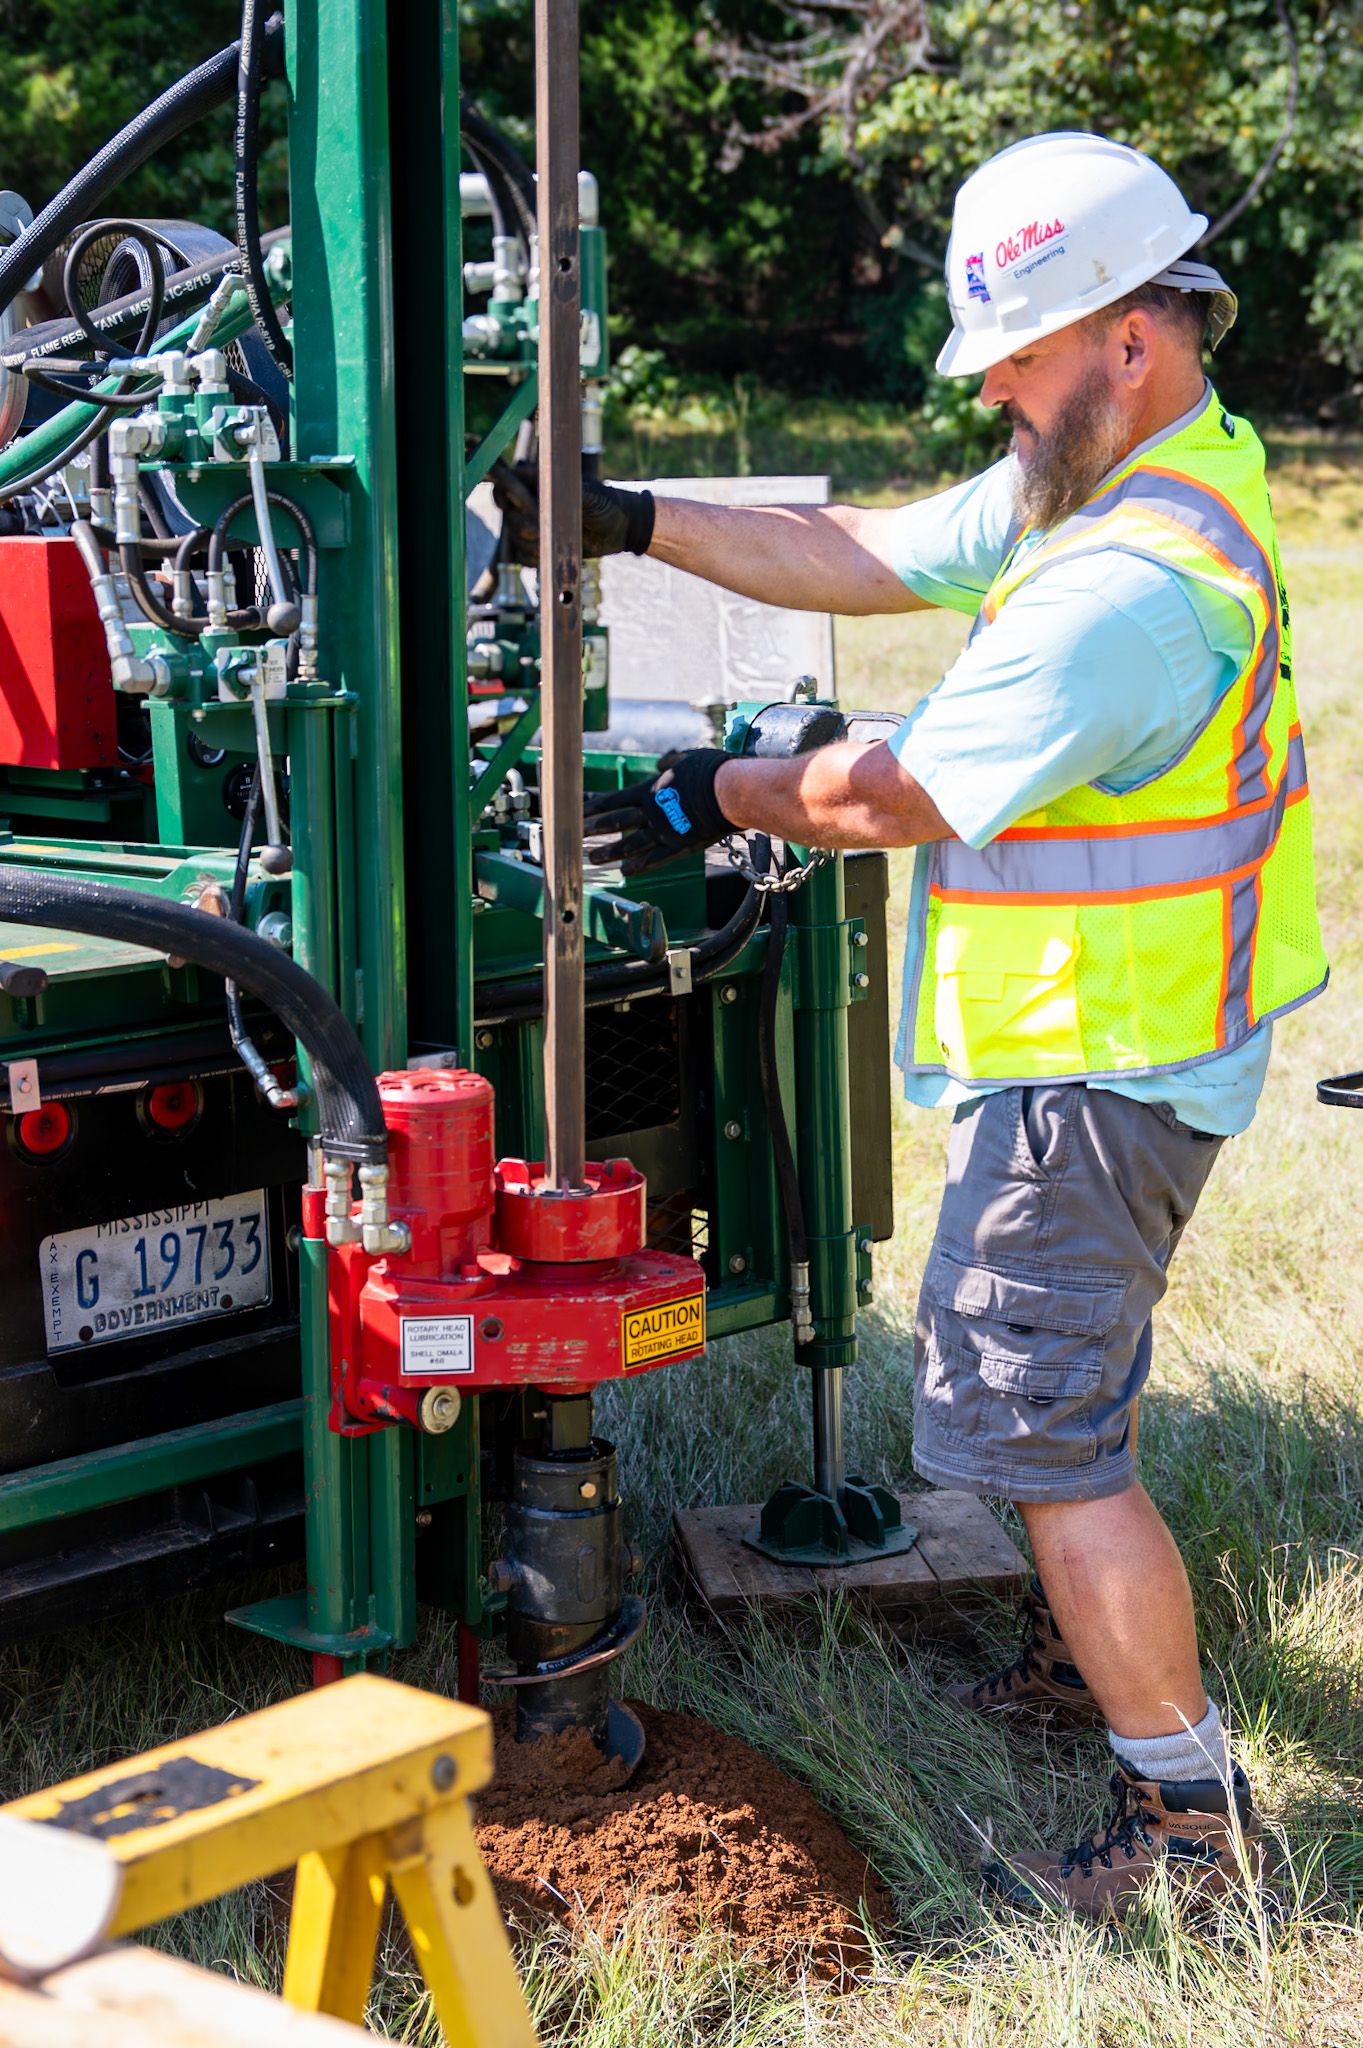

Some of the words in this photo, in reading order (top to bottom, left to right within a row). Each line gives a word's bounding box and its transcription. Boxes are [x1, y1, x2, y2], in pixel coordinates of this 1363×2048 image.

[238, 91, 247, 117] 4000
[236, 119, 246, 137] PSI
[236, 139, 245, 157] WP
[235, 172, 245, 210] FLAME
[237, 213, 252, 275] RESISTANT
[996, 236, 1022, 268] Ole
[1016, 218, 1065, 252] Miss
[1013, 245, 1065, 279] Engineering
[30, 340, 62, 358] FLAME
[61, 310, 125, 348] RESIANT
[169, 272, 212, 300] IC-8/19
[246, 284, 261, 315] MSHA
[76, 1248, 100, 1311] G
[132, 1212, 262, 1300] 19733
[50, 1273, 63, 1343] EXEMPT
[93, 1286, 221, 1333] GOVERNMENT
[629, 1302, 700, 1339] CAUTION
[407, 1325, 440, 1334] ROTARY
[442, 1324, 466, 1332] HEAD
[409, 1333, 464, 1342] LUBRICATION
[631, 1338, 673, 1359] ROTATING
[675, 1330, 699, 1346] HEAD
[411, 1350, 435, 1358] SHELL
